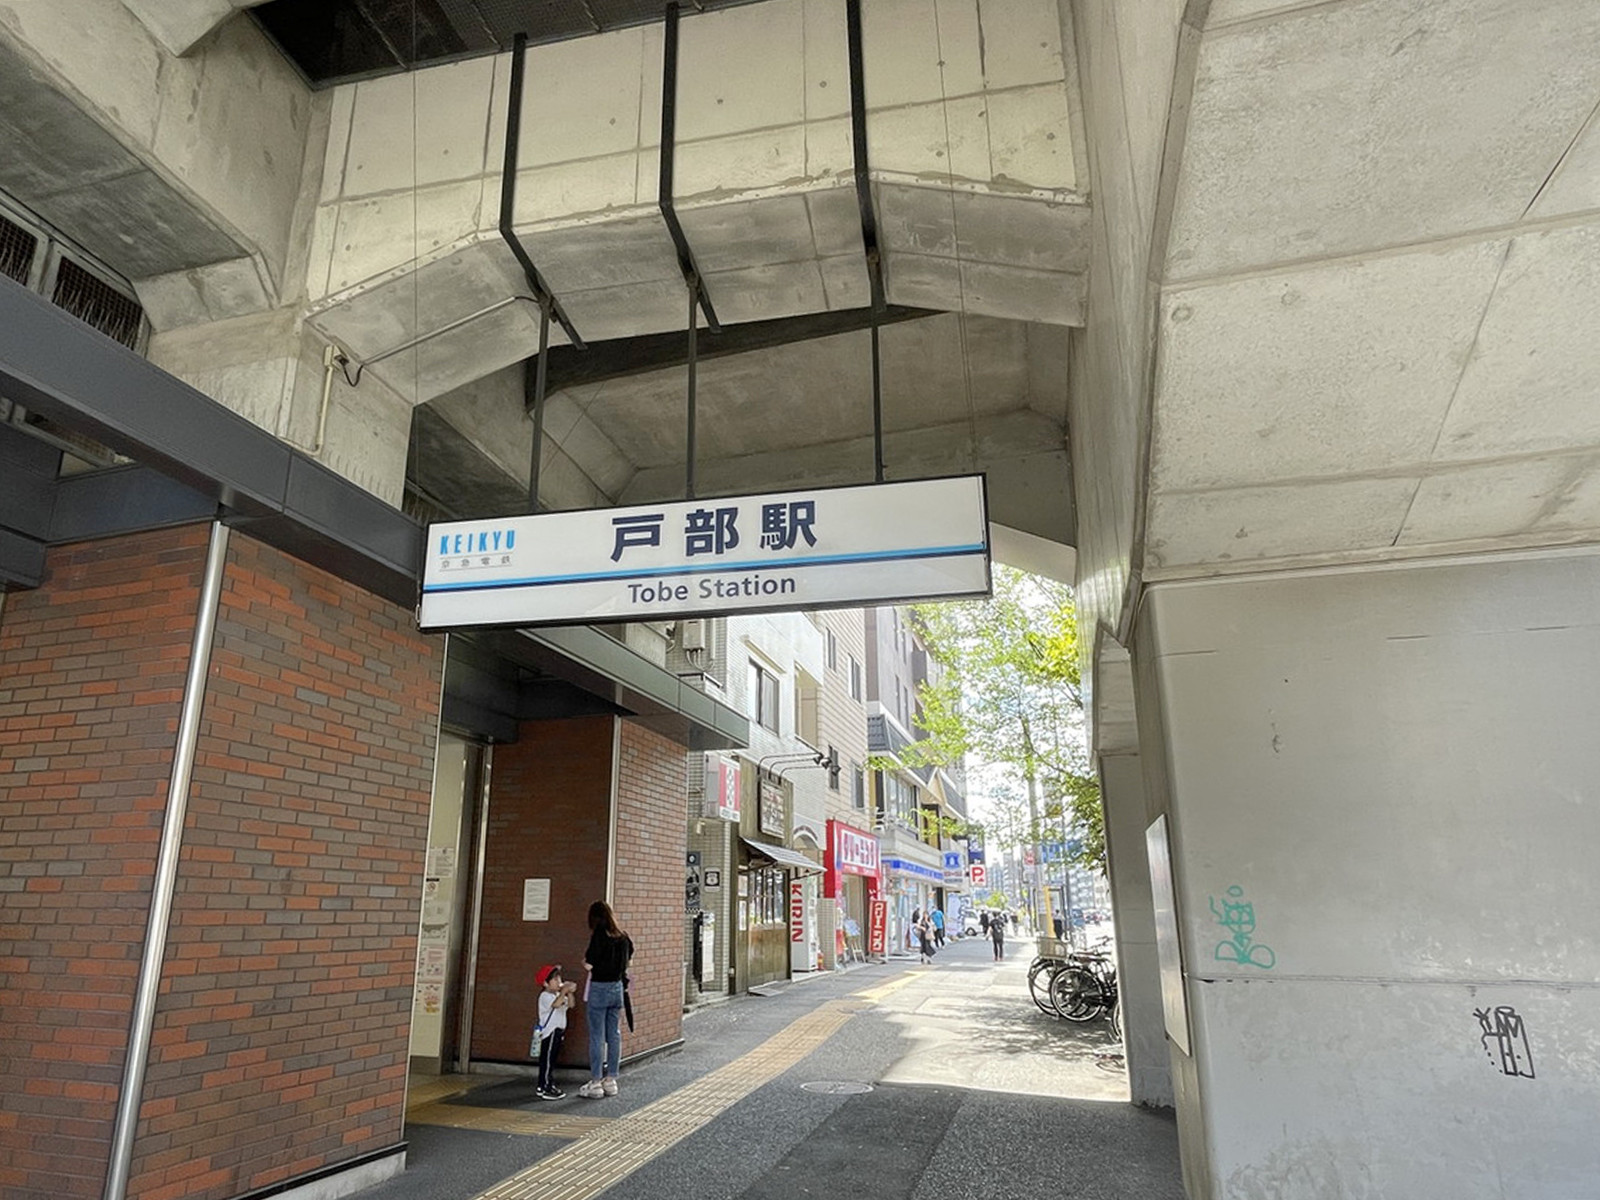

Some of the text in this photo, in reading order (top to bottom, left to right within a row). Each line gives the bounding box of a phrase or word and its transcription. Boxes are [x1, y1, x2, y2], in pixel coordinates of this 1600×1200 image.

[440, 529, 516, 555] KEIKYU
[610, 500, 818, 563] 戸部駅
[627, 574, 796, 604] Tobe Station
[972, 866, 984, 883] P
[791, 884, 804, 943] KIRIN
